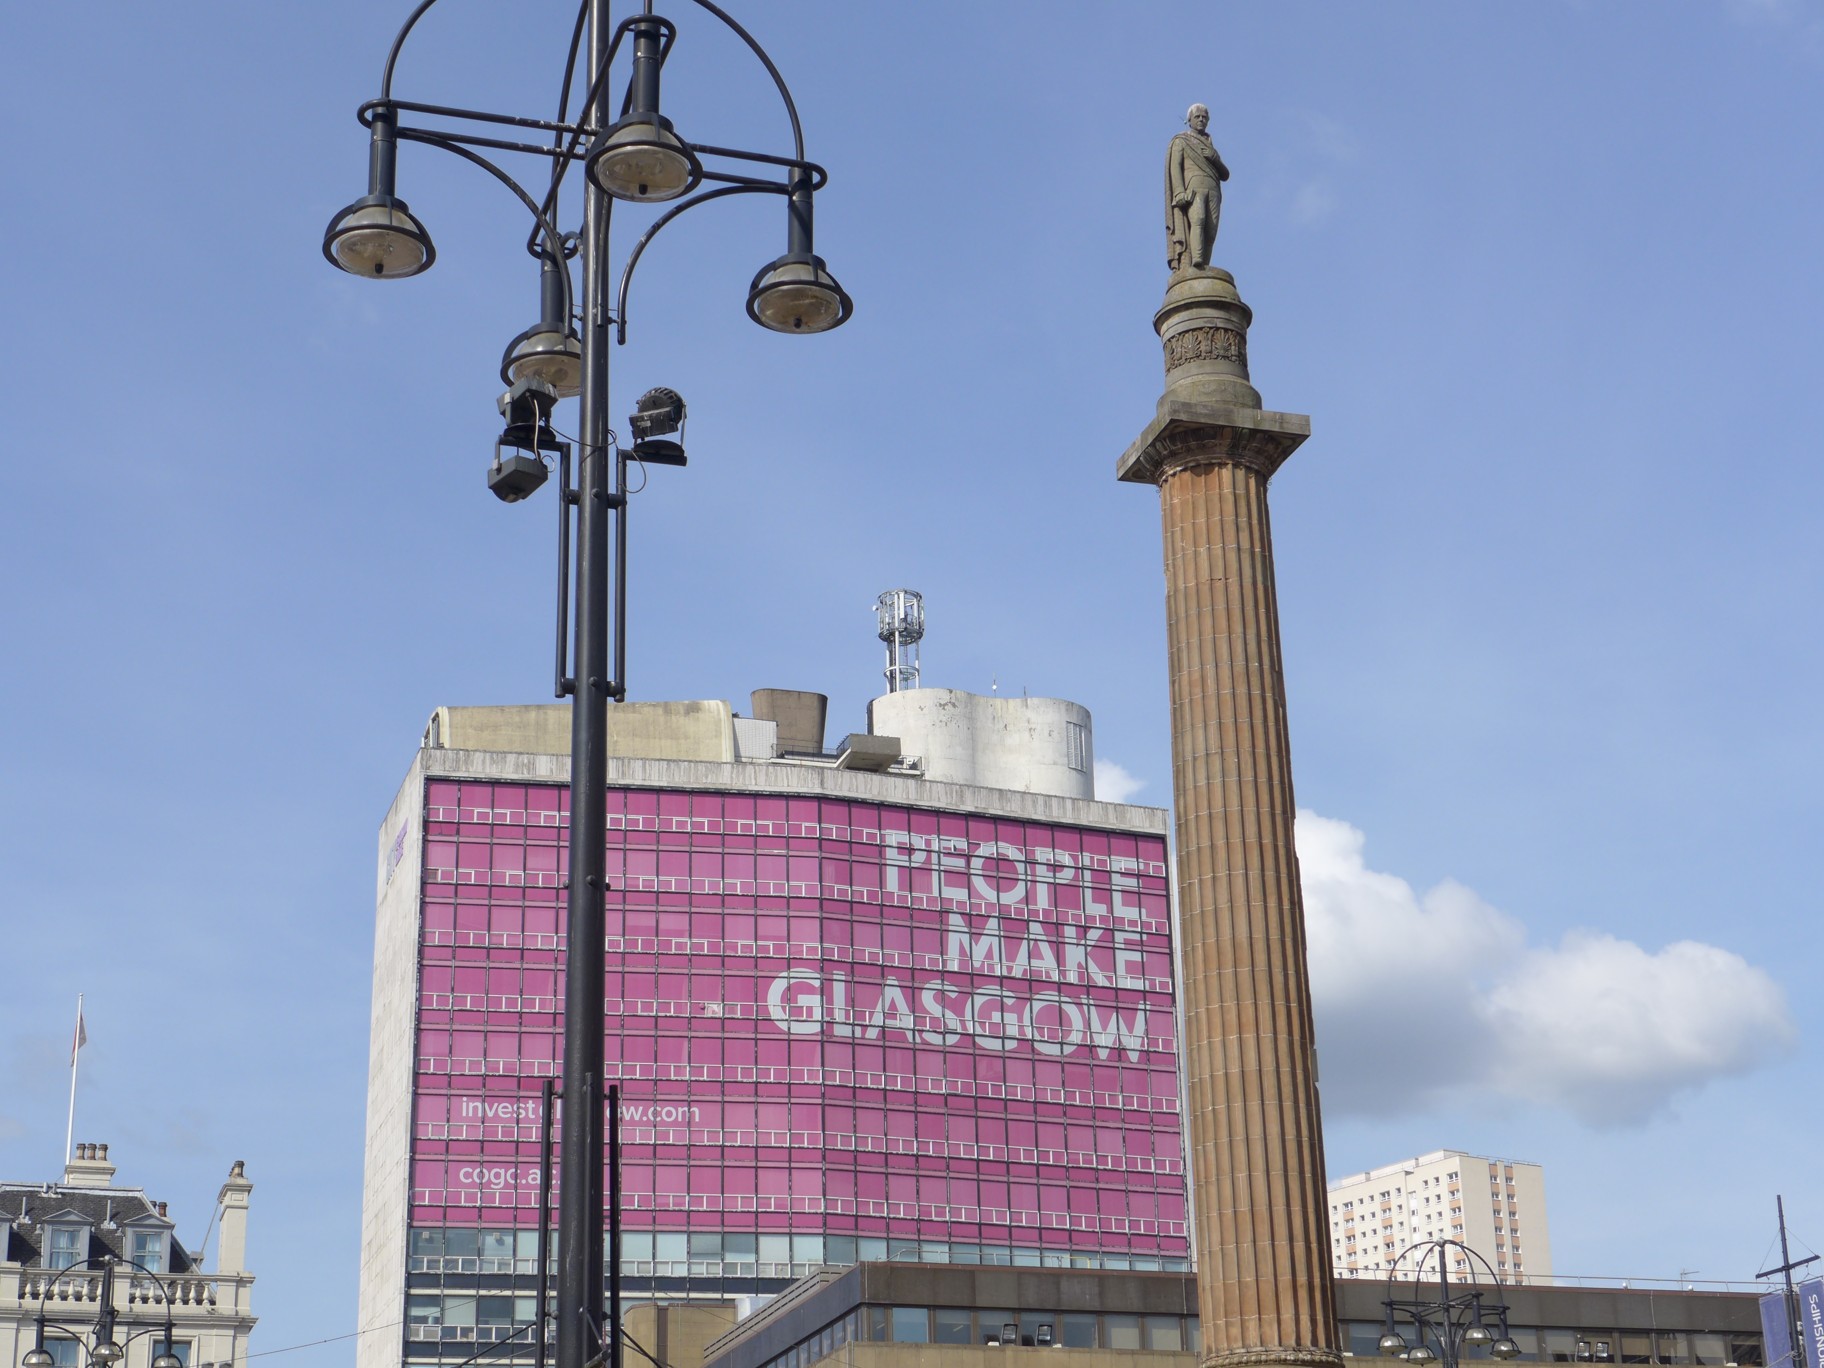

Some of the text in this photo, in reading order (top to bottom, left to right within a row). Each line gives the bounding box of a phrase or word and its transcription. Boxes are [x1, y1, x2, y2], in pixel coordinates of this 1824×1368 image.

[883, 829, 1147, 919] PEOPLE
[946, 912, 1148, 990] MAKE
[766, 968, 1151, 1063] GLASGOW
[461, 1096, 701, 1124] investlw.com
